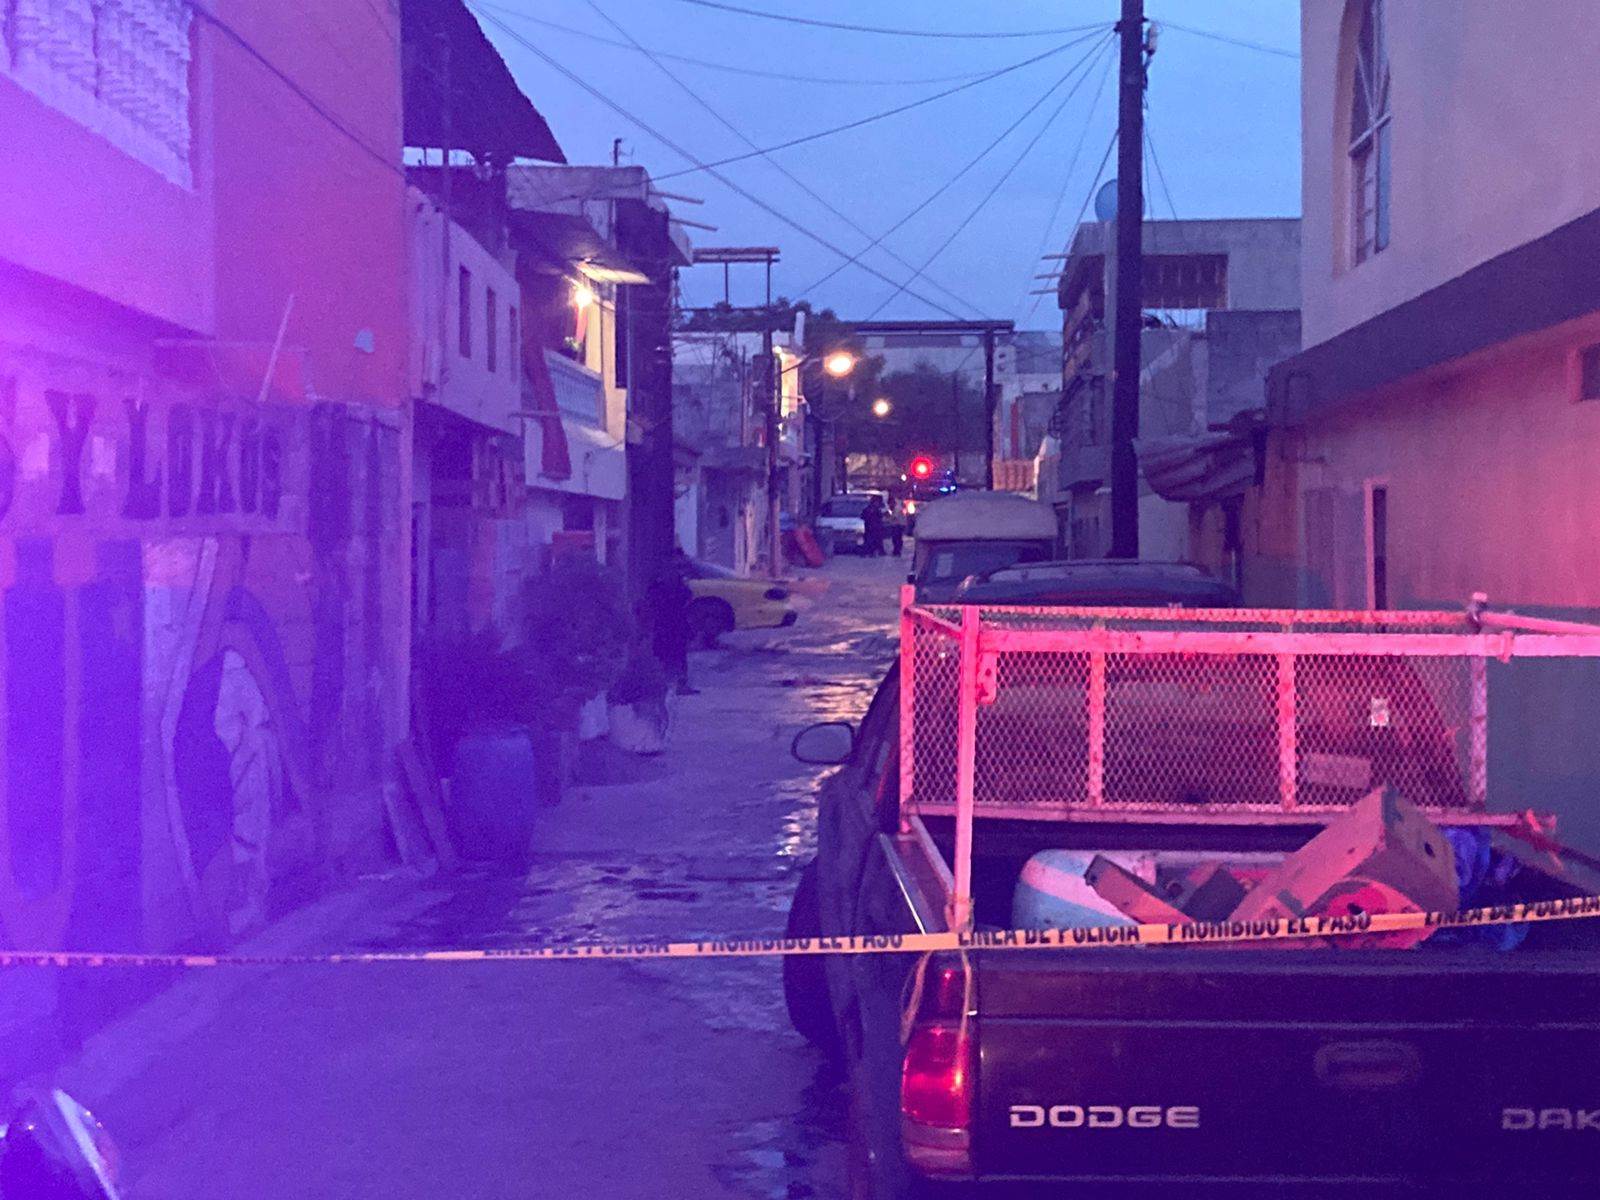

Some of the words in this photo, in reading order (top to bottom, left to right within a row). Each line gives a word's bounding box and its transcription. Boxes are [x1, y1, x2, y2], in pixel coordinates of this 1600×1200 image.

[696, 936, 812, 952] PROHIBIDO
[818, 936, 842, 949] EL
[849, 933, 904, 949] PASO
[958, 929, 1018, 946] LINEA
[1024, 928, 1051, 944] DE
[1058, 925, 1140, 943] POLICIA
[1167, 921, 1281, 940] PROHIBIDO
[1286, 918, 1311, 934] EL
[1317, 913, 1372, 932] PASO
[1009, 1105, 1200, 1128] DODGE
[1502, 1108, 1600, 1130] DAK
